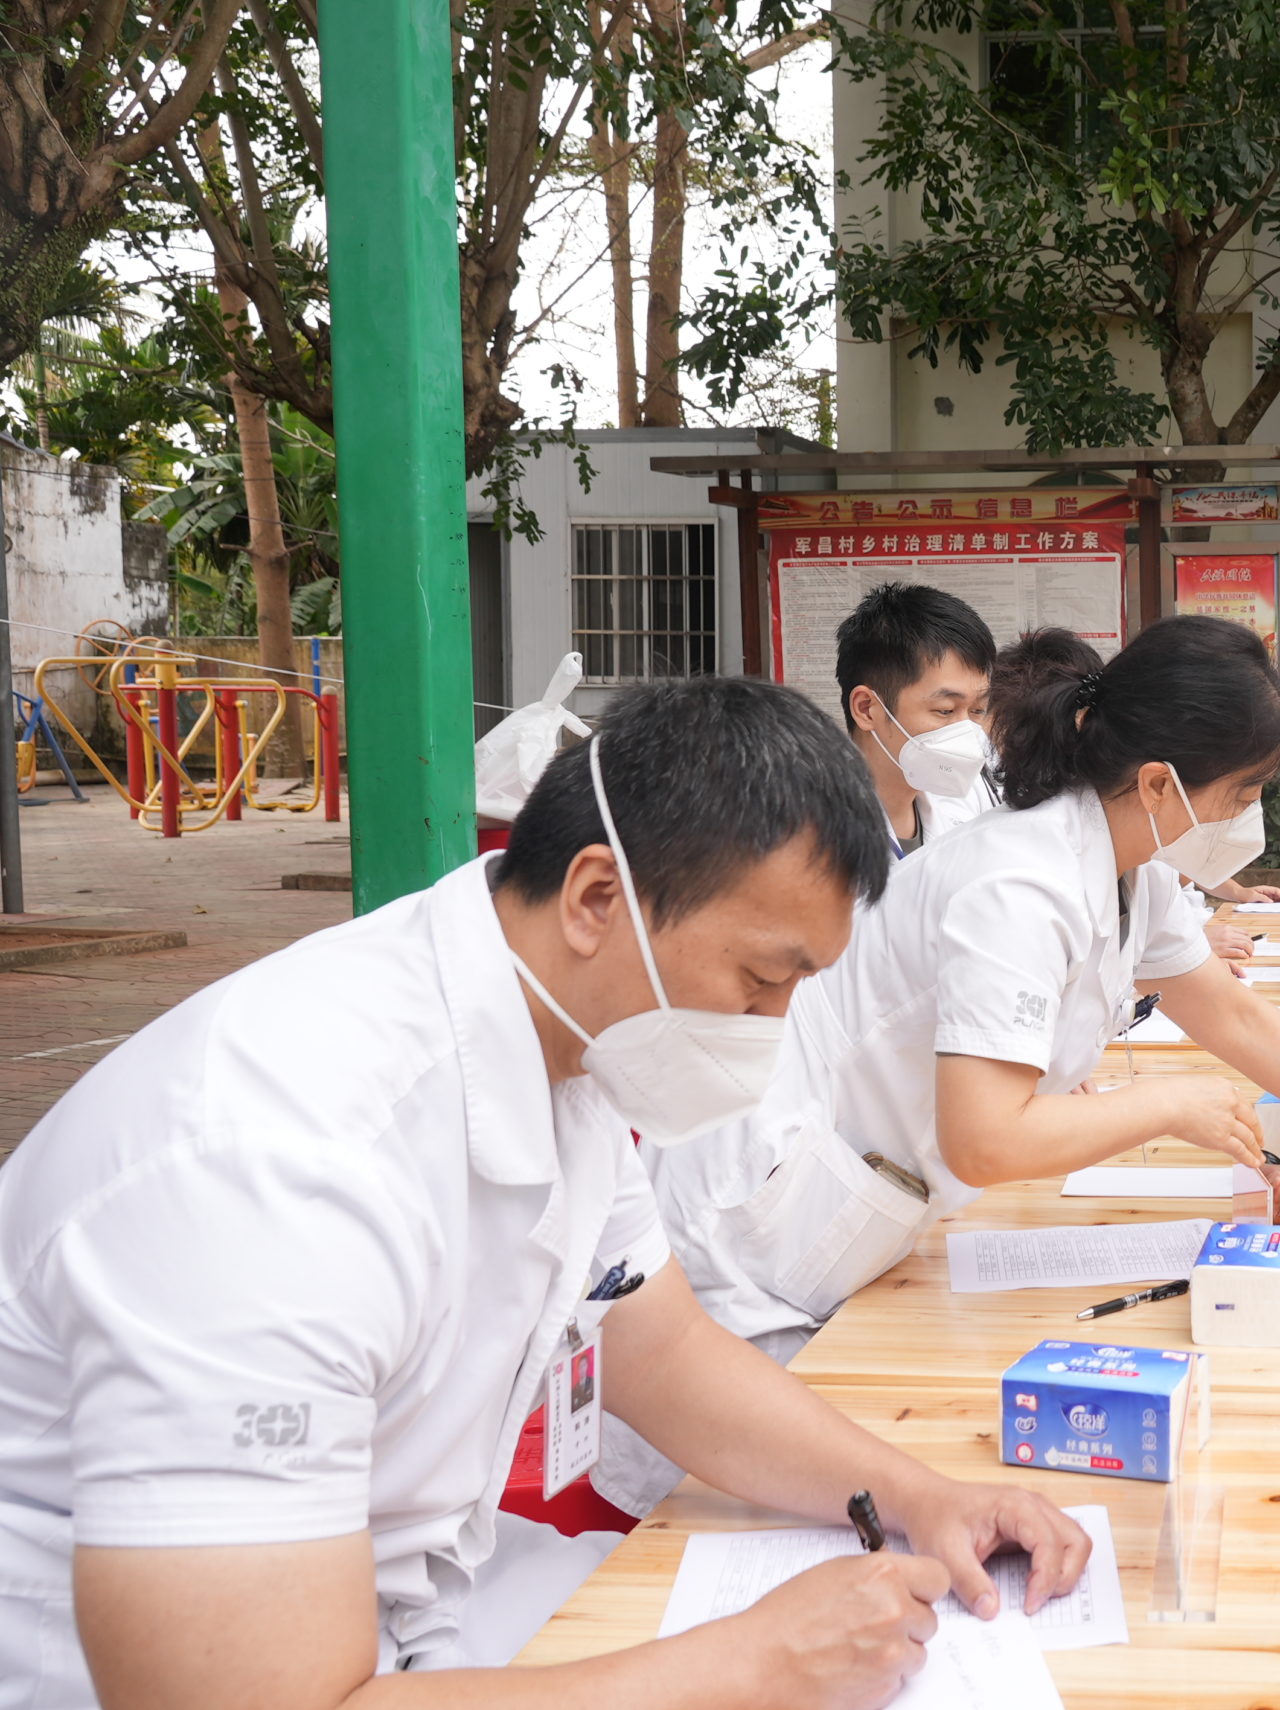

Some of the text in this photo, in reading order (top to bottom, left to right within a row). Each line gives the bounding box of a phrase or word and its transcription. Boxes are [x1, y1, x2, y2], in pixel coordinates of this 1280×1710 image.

[819, 497, 1080, 522] 公告公示信息栏
[794, 531, 1101, 555] 军昌村乡村治理清单制工作方案
